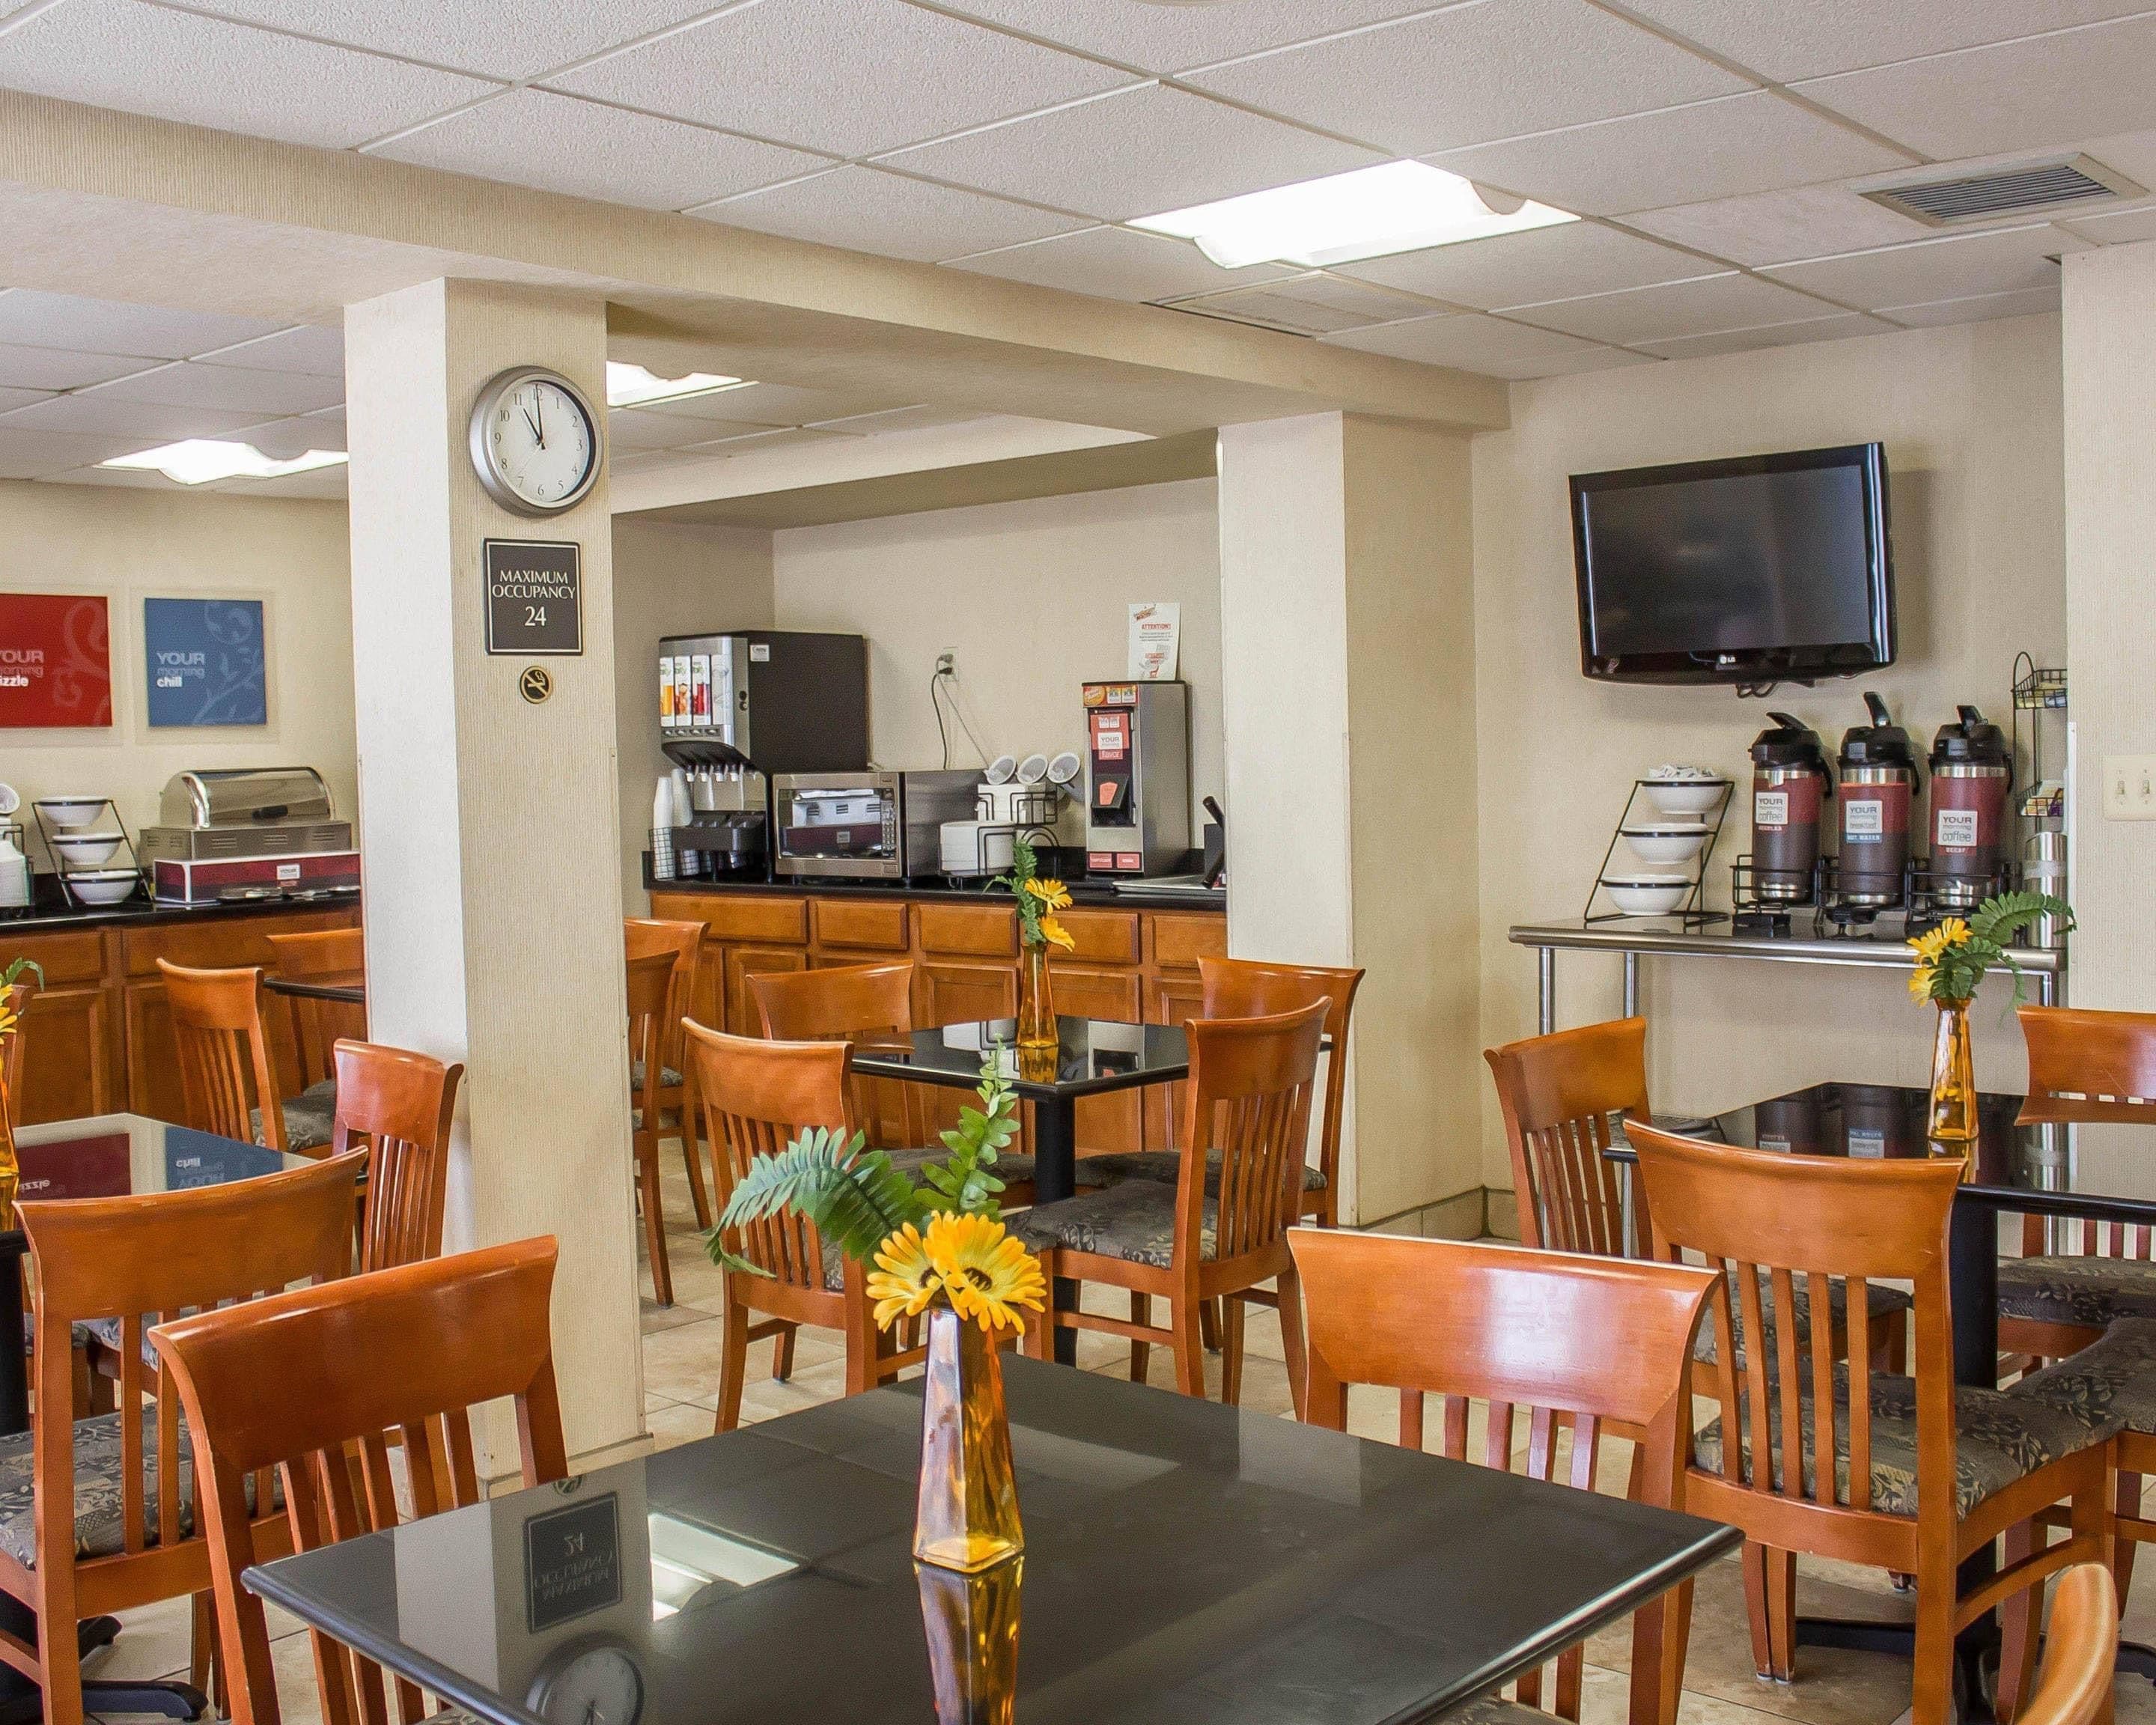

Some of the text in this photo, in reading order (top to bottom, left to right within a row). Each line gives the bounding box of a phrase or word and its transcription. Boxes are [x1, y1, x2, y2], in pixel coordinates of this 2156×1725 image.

[514, 393, 523, 406] 11
[533, 388, 543, 401] 12
[555, 397, 561, 410] 1
[499, 410, 510, 422] 10
[571, 416, 579, 428] 2
[494, 433, 502, 444] 9
[576, 439, 582, 451] 3
[501, 458, 508, 469] 8
[571, 466, 578, 475] 4
[517, 476, 524, 488] 7
[558, 480, 564, 490] 5
[538, 484, 544, 496] 6
[499, 570, 569, 584] MAXIMUM
[492, 584, 576, 599] OCCUPANCY
[525, 606, 546, 627] 24
[156, 652, 205, 666] YOUR
[0, 675, 29, 687] izzle
[156, 676, 183, 688] chill
[1758, 811, 1783, 822] coffee
[1942, 830, 1972, 842] coffee
